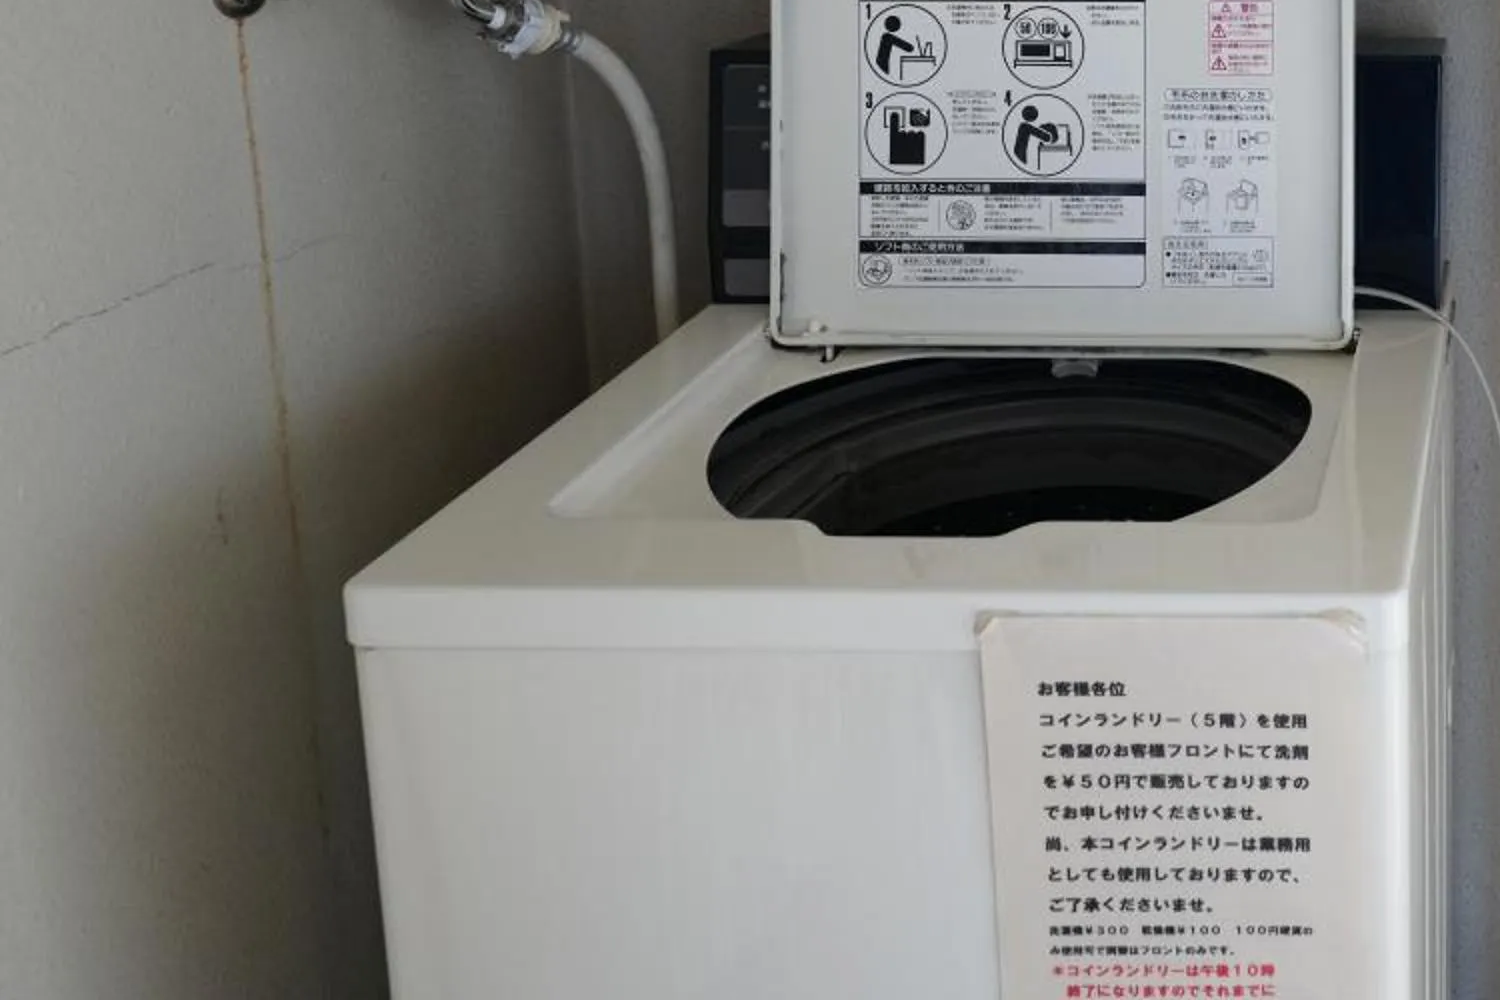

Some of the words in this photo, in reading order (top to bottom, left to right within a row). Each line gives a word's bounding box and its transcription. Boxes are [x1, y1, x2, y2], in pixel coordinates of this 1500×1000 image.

[866, 3, 872, 20] 1
[1003, 3, 1012, 20] 2
[865, 92, 873, 109] 3
[1004, 90, 1012, 107] 4
[1037, 680, 1127, 697] お客様各位
[1039, 712, 1308, 729] コインランドリー（5階）を使用
[1041, 743, 1309, 761] ご希望のお客様フロントにて洗剤
[1043, 774, 1310, 791] を¥50円で販売しておりますの
[1043, 804, 1264, 822] でお申し付けくださいませ。
[1044, 836, 1311, 853] 尚、本コインランドリーは業務用
[1047, 866, 1301, 884] としても使用しておりますので、
[1048, 897, 1214, 914] ご了承くださいませ。
[1065, 983, 1275, 999] 終了になりますのでそれまでに
